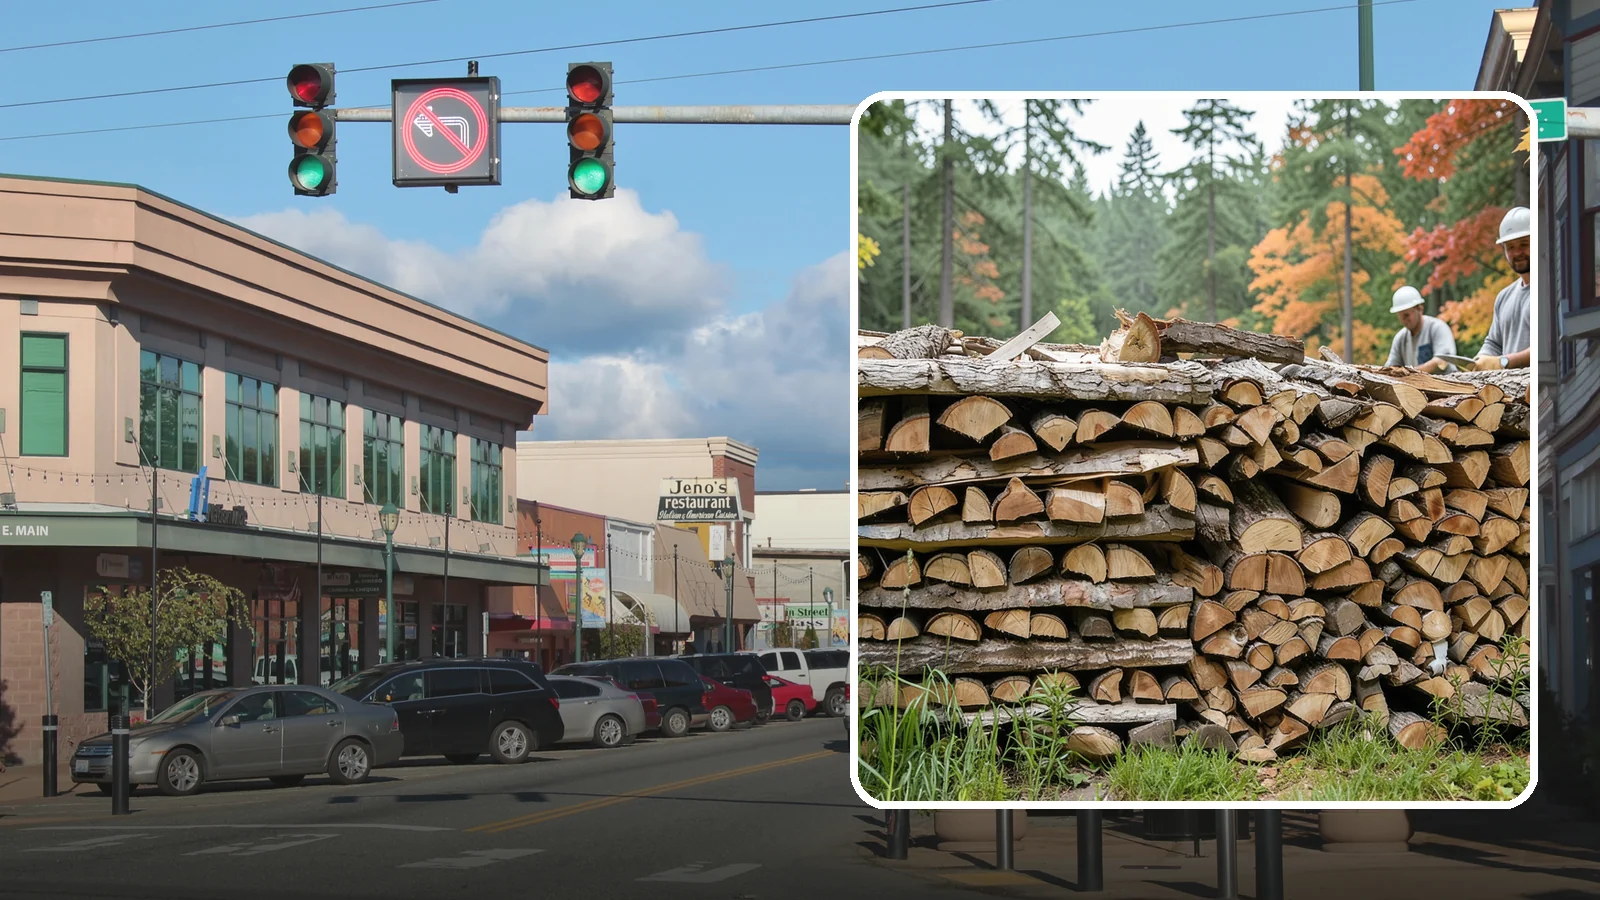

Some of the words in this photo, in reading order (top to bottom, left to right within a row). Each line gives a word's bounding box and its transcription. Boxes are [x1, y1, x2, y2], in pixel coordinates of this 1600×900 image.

[669, 479, 727, 495] Jeno's
[665, 495, 731, 509] restaurant
[658, 509, 682, 520] Italian
[686, 509, 714, 520] American
[714, 509, 737, 520] Cuisine
[2, 525, 13, 536] E.
[15, 525, 49, 537] MAIN
[797, 607, 829, 617] Street
